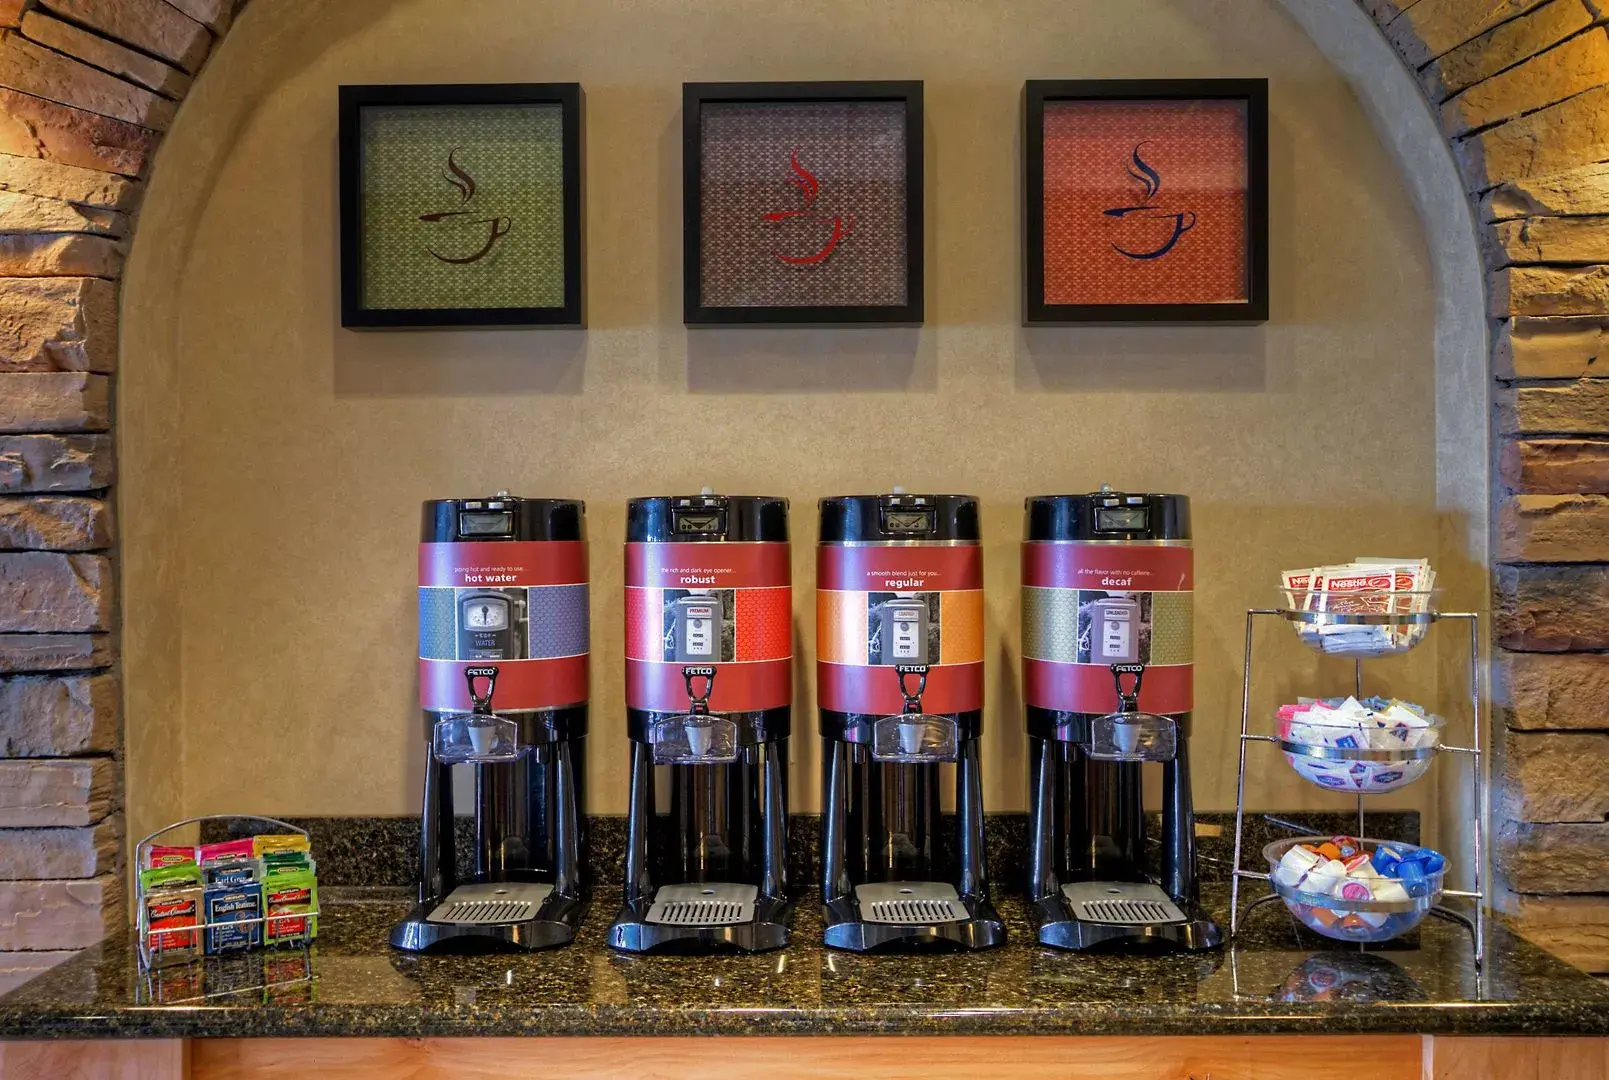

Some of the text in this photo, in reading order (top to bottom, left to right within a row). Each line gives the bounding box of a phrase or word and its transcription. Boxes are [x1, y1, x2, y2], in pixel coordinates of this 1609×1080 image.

[465, 574, 517, 582] hot water
[680, 575, 716, 584] robust
[1101, 577, 1132, 585] decaf
[885, 578, 924, 588] regular
[467, 668, 494, 676] FETCO
[685, 667, 712, 675] FETCO
[214, 902, 235, 913] English
